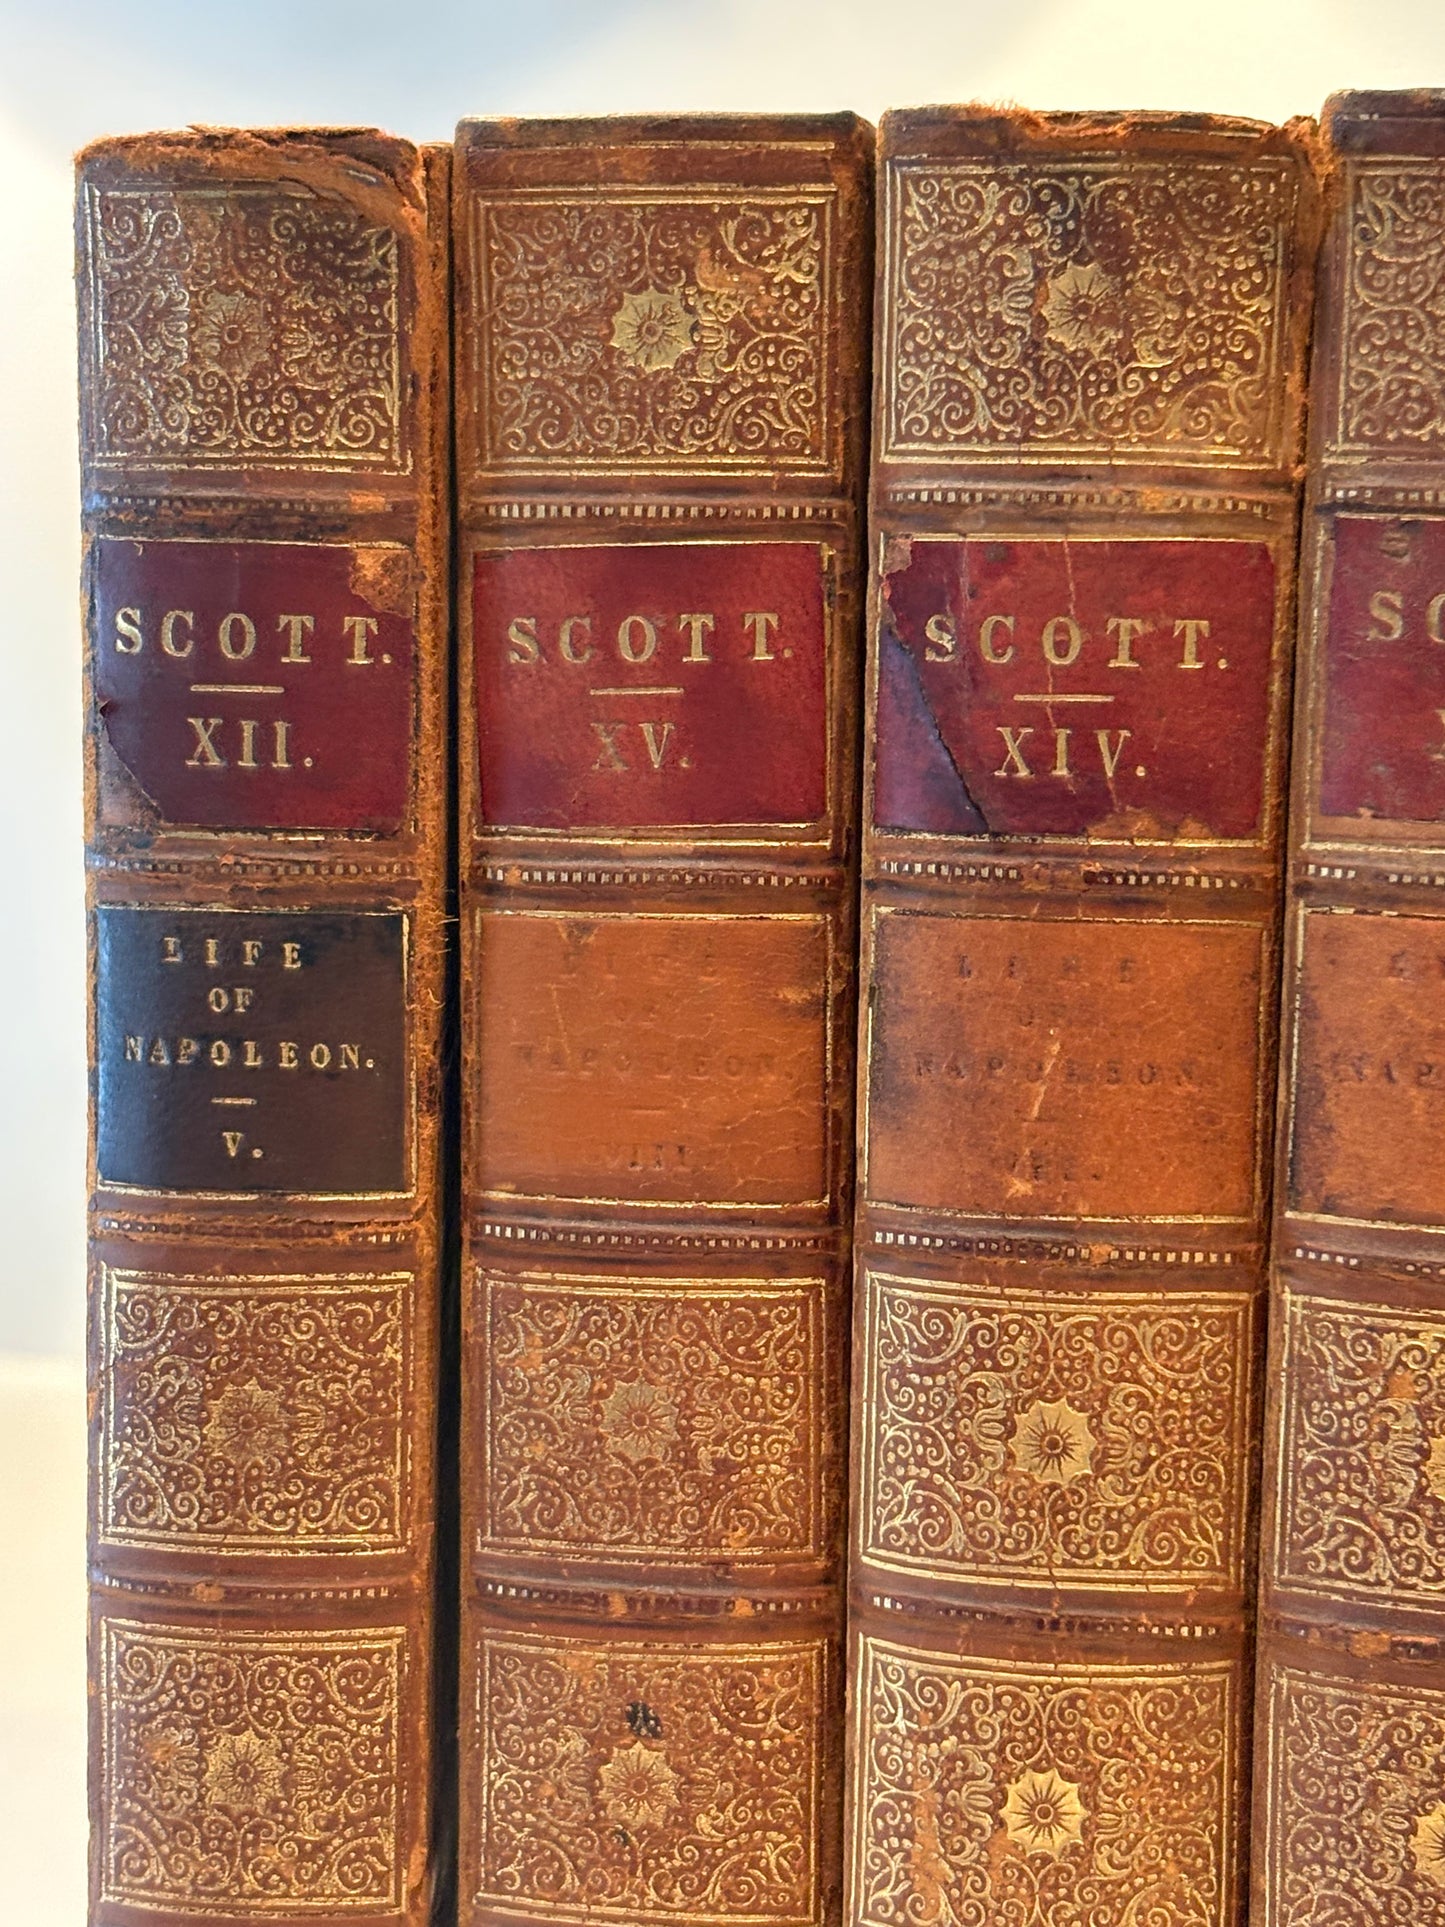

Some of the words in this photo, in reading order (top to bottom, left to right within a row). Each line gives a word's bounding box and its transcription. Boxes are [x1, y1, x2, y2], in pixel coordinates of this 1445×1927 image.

[114, 606, 394, 665] SCOTT.
[507, 612, 795, 664] SCOTT.
[924, 613, 1231, 670] SCOTT.
[185, 717, 313, 768] XII.
[590, 722, 693, 771] XV.
[994, 727, 1147, 779] XIV.
[161, 936, 303, 969] LIFE
[208, 987, 255, 1014] OF
[125, 1035, 376, 1070] NAPOLEON.
[222, 1131, 264, 1160] V.
